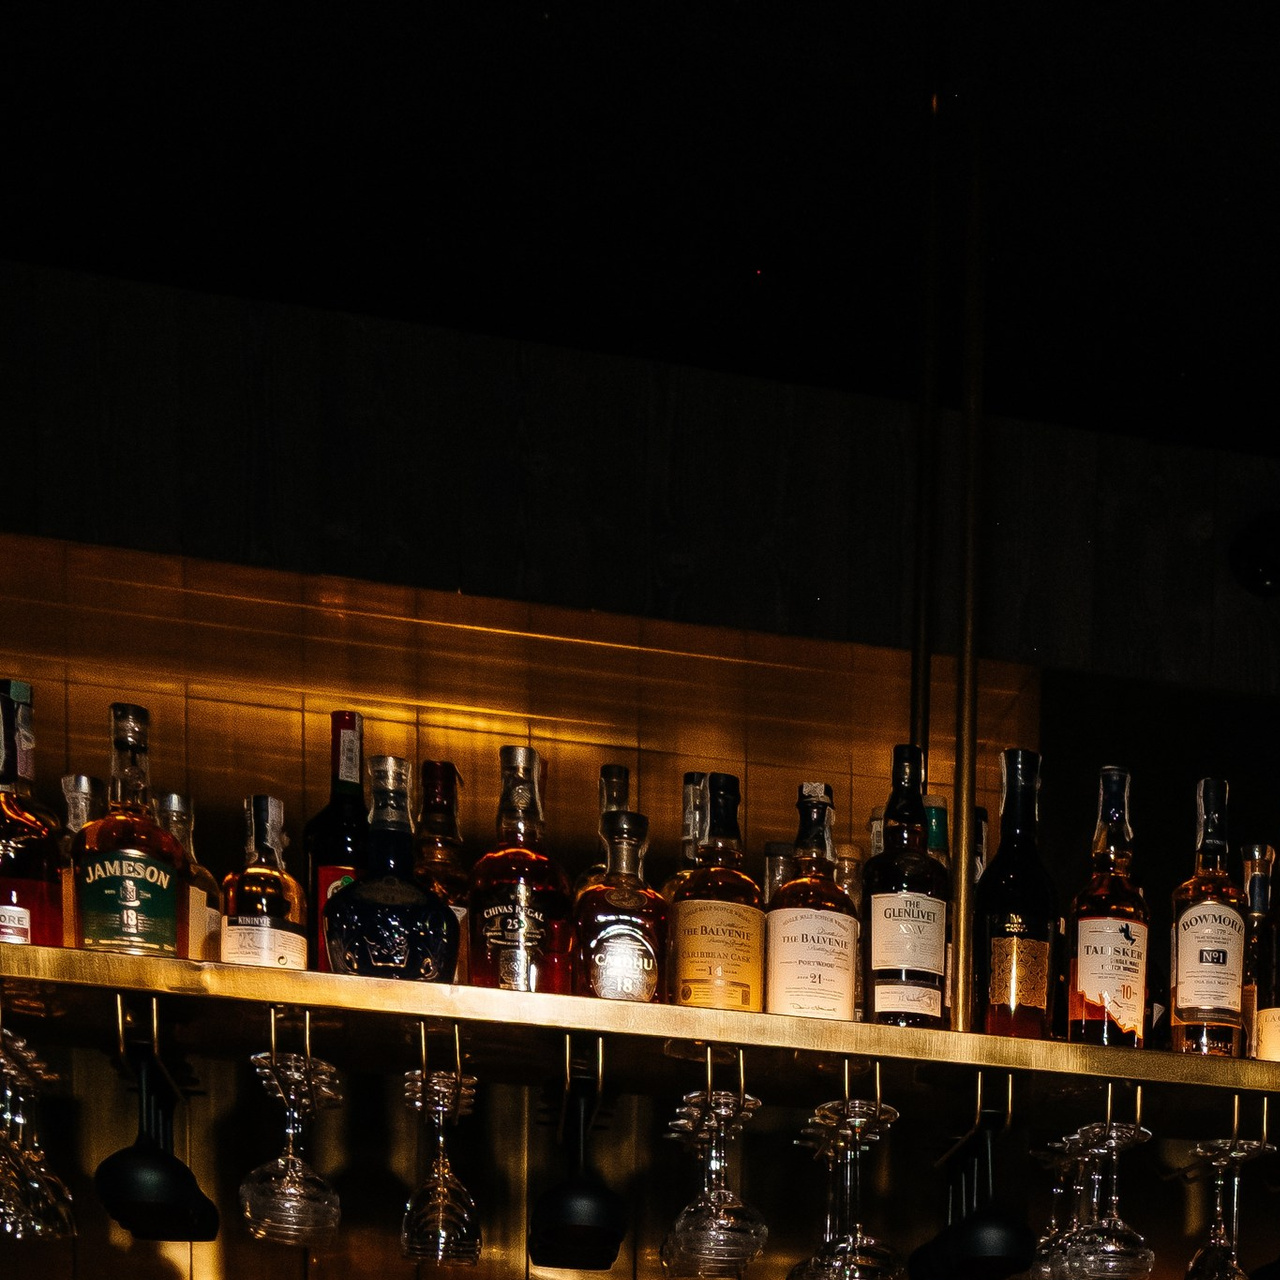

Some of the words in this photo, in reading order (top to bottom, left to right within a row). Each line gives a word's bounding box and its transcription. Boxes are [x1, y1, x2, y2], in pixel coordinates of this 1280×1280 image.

[86, 860, 170, 889] JAMESON
[904, 900, 921, 909] THE
[123, 910, 137, 925] 18
[483, 905, 513, 918] CHIVAS
[515, 906, 545, 922] REGAL
[884, 908, 937, 923] GLENLIVET
[506, 919, 519, 929] 25
[1181, 913, 1244, 935] BOWMORE
[683, 927, 698, 936] THE
[700, 925, 751, 941] BALVENIE
[782, 935, 799, 943] THE
[801, 934, 849, 950] BALVENIE
[681, 951, 728, 960] CARIBBEAN
[730, 953, 751, 963] CASK
[1084, 945, 1143, 960] TALISKER
[707, 965, 722, 977] 14
[798, 959, 835, 968] PORTWOOD
[809, 973, 822, 984] 21
[1121, 985, 1133, 1000] 10
